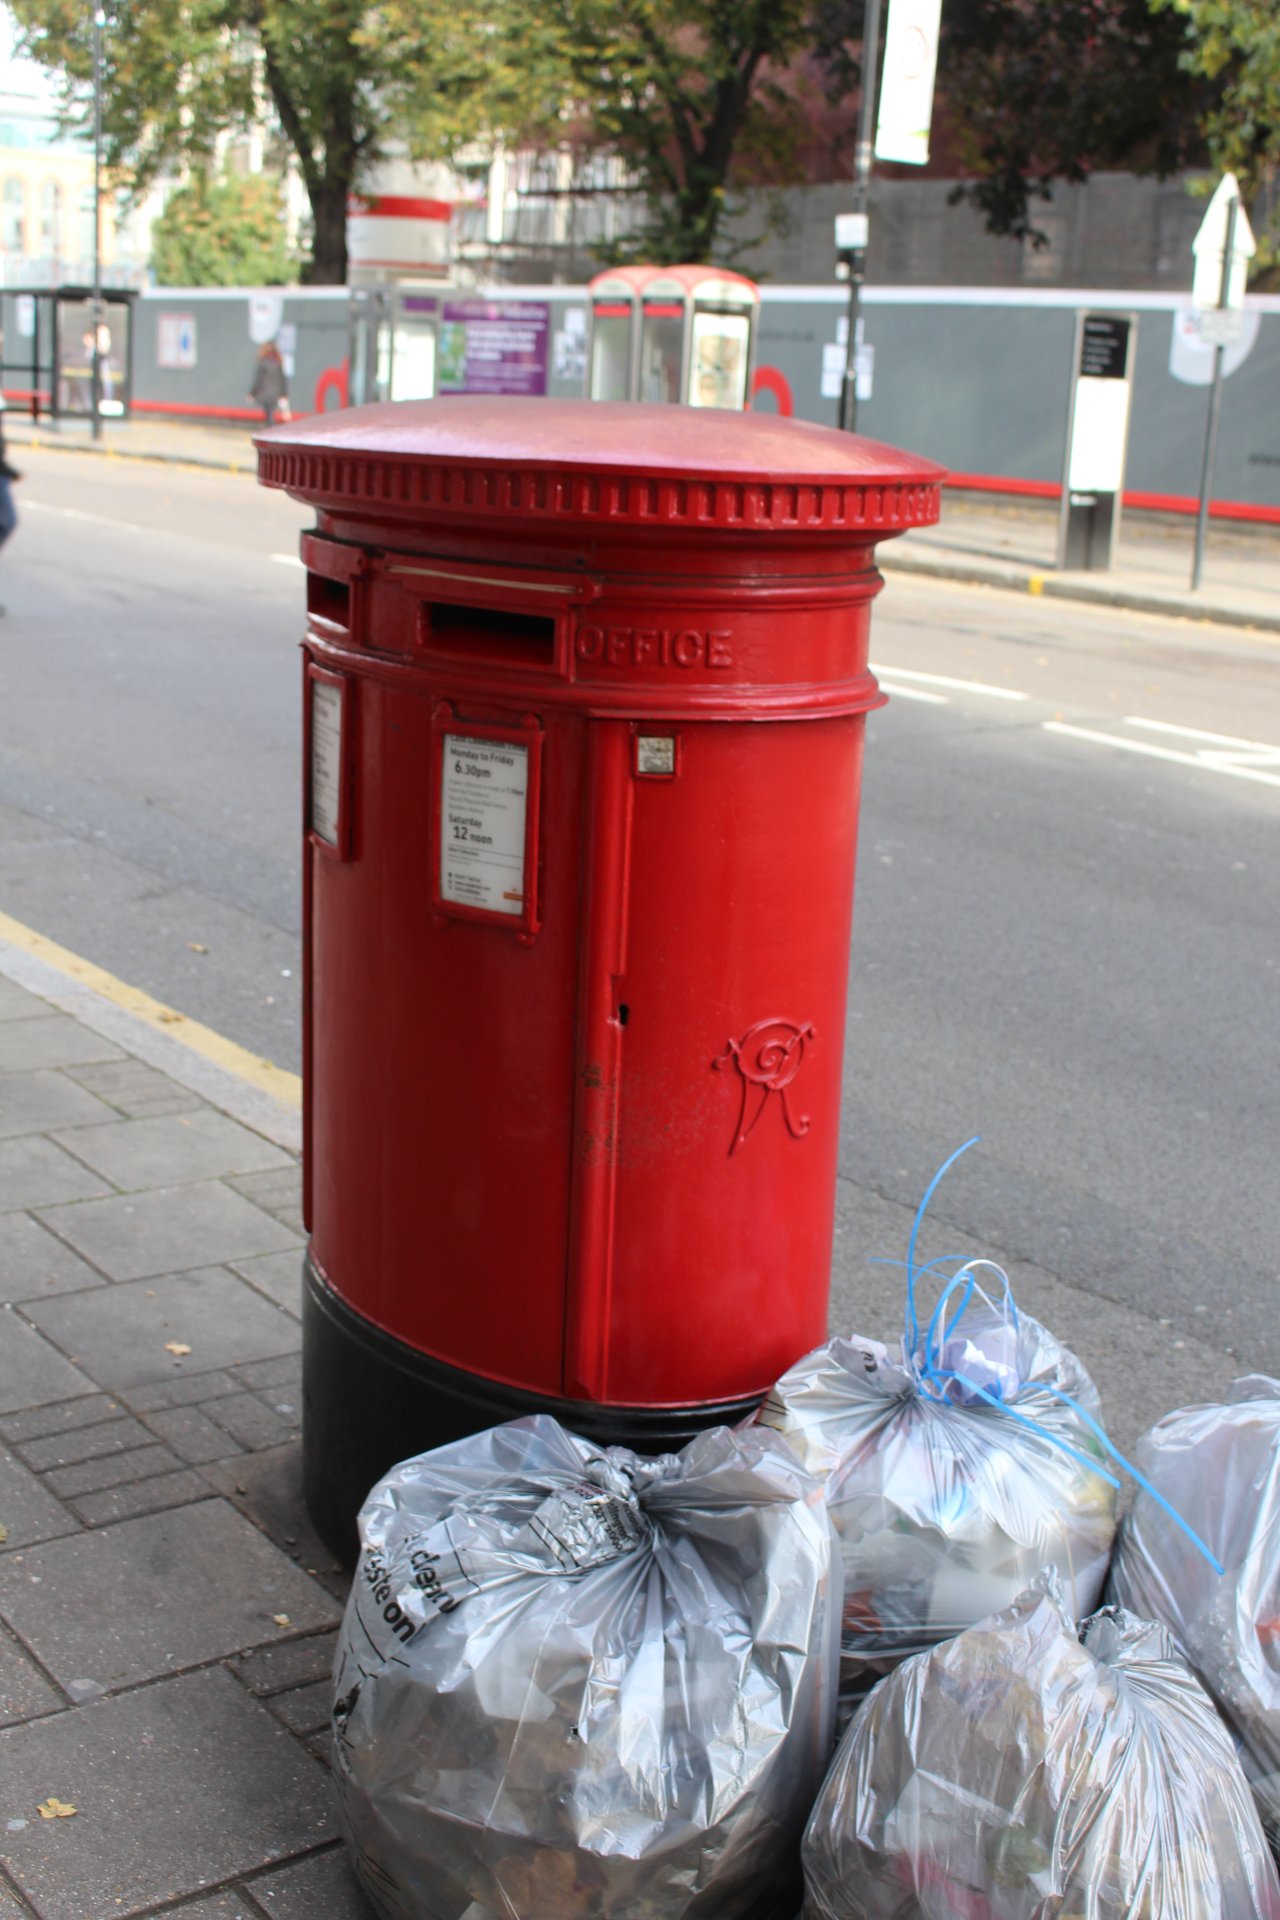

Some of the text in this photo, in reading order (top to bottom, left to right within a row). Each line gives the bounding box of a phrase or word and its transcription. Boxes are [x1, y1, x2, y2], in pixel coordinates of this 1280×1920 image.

[576, 626, 733, 668] OFFICE
[450, 748, 514, 767] Monday to Friday
[455, 760, 491, 778] 6.30pm
[449, 813, 482, 829] Saturday
[454, 826, 493, 845] 12 noon
[382, 1601, 416, 1643] on
